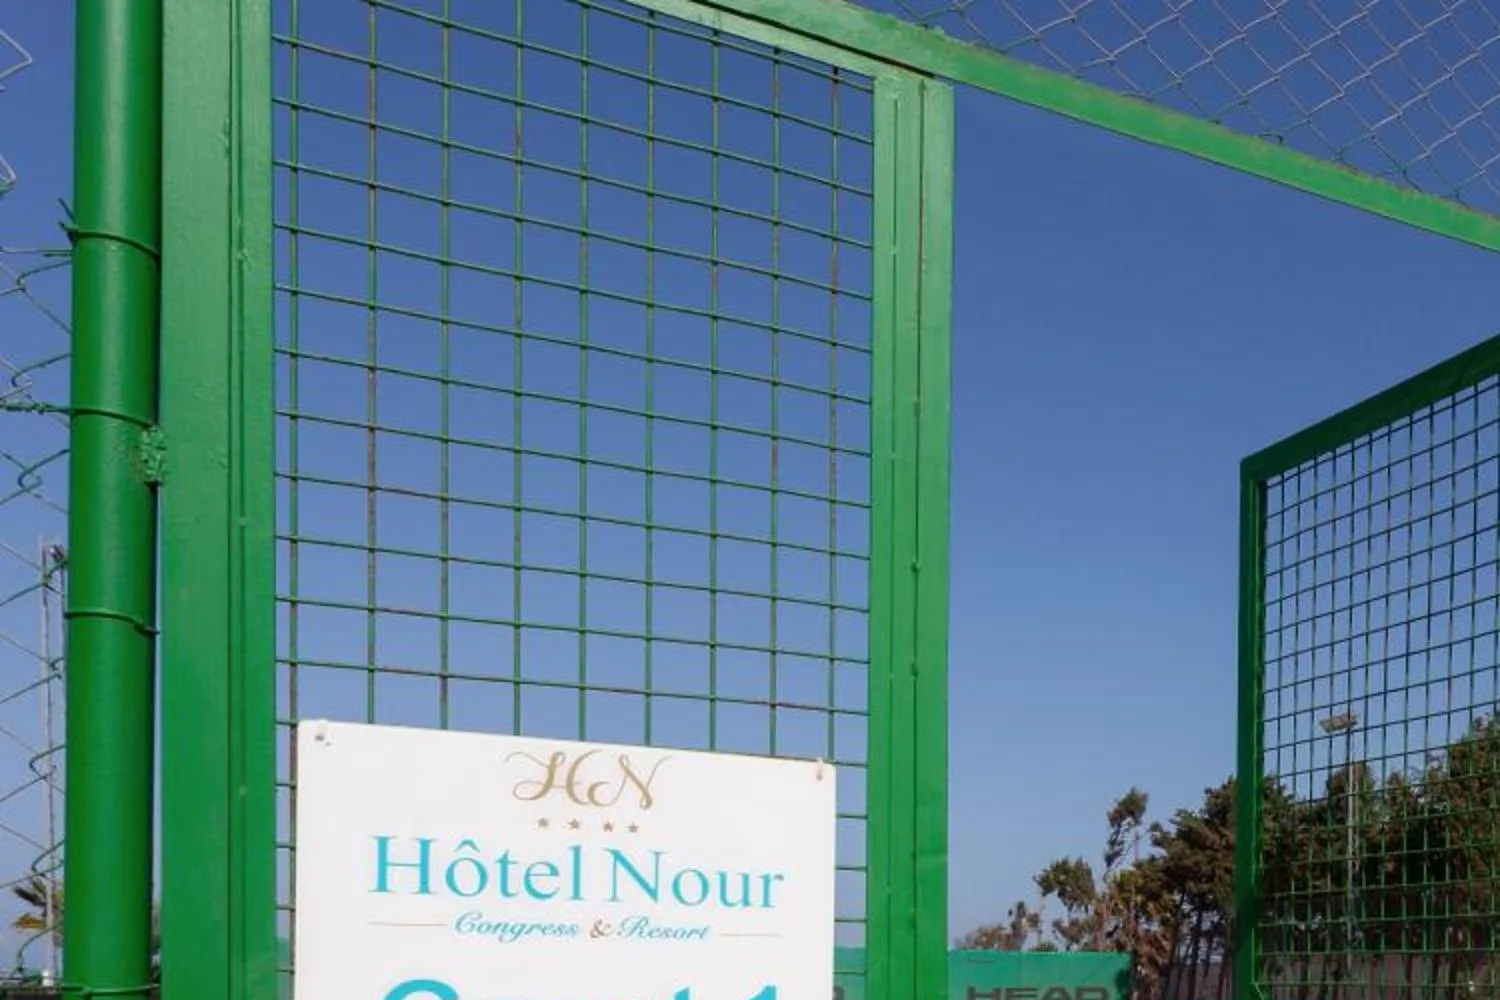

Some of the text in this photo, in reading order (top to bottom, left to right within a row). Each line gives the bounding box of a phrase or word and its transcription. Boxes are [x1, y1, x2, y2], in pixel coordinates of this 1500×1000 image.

[367, 835, 785, 909] Hôtel Nour
[454, 911, 709, 943] Congress & Resort
